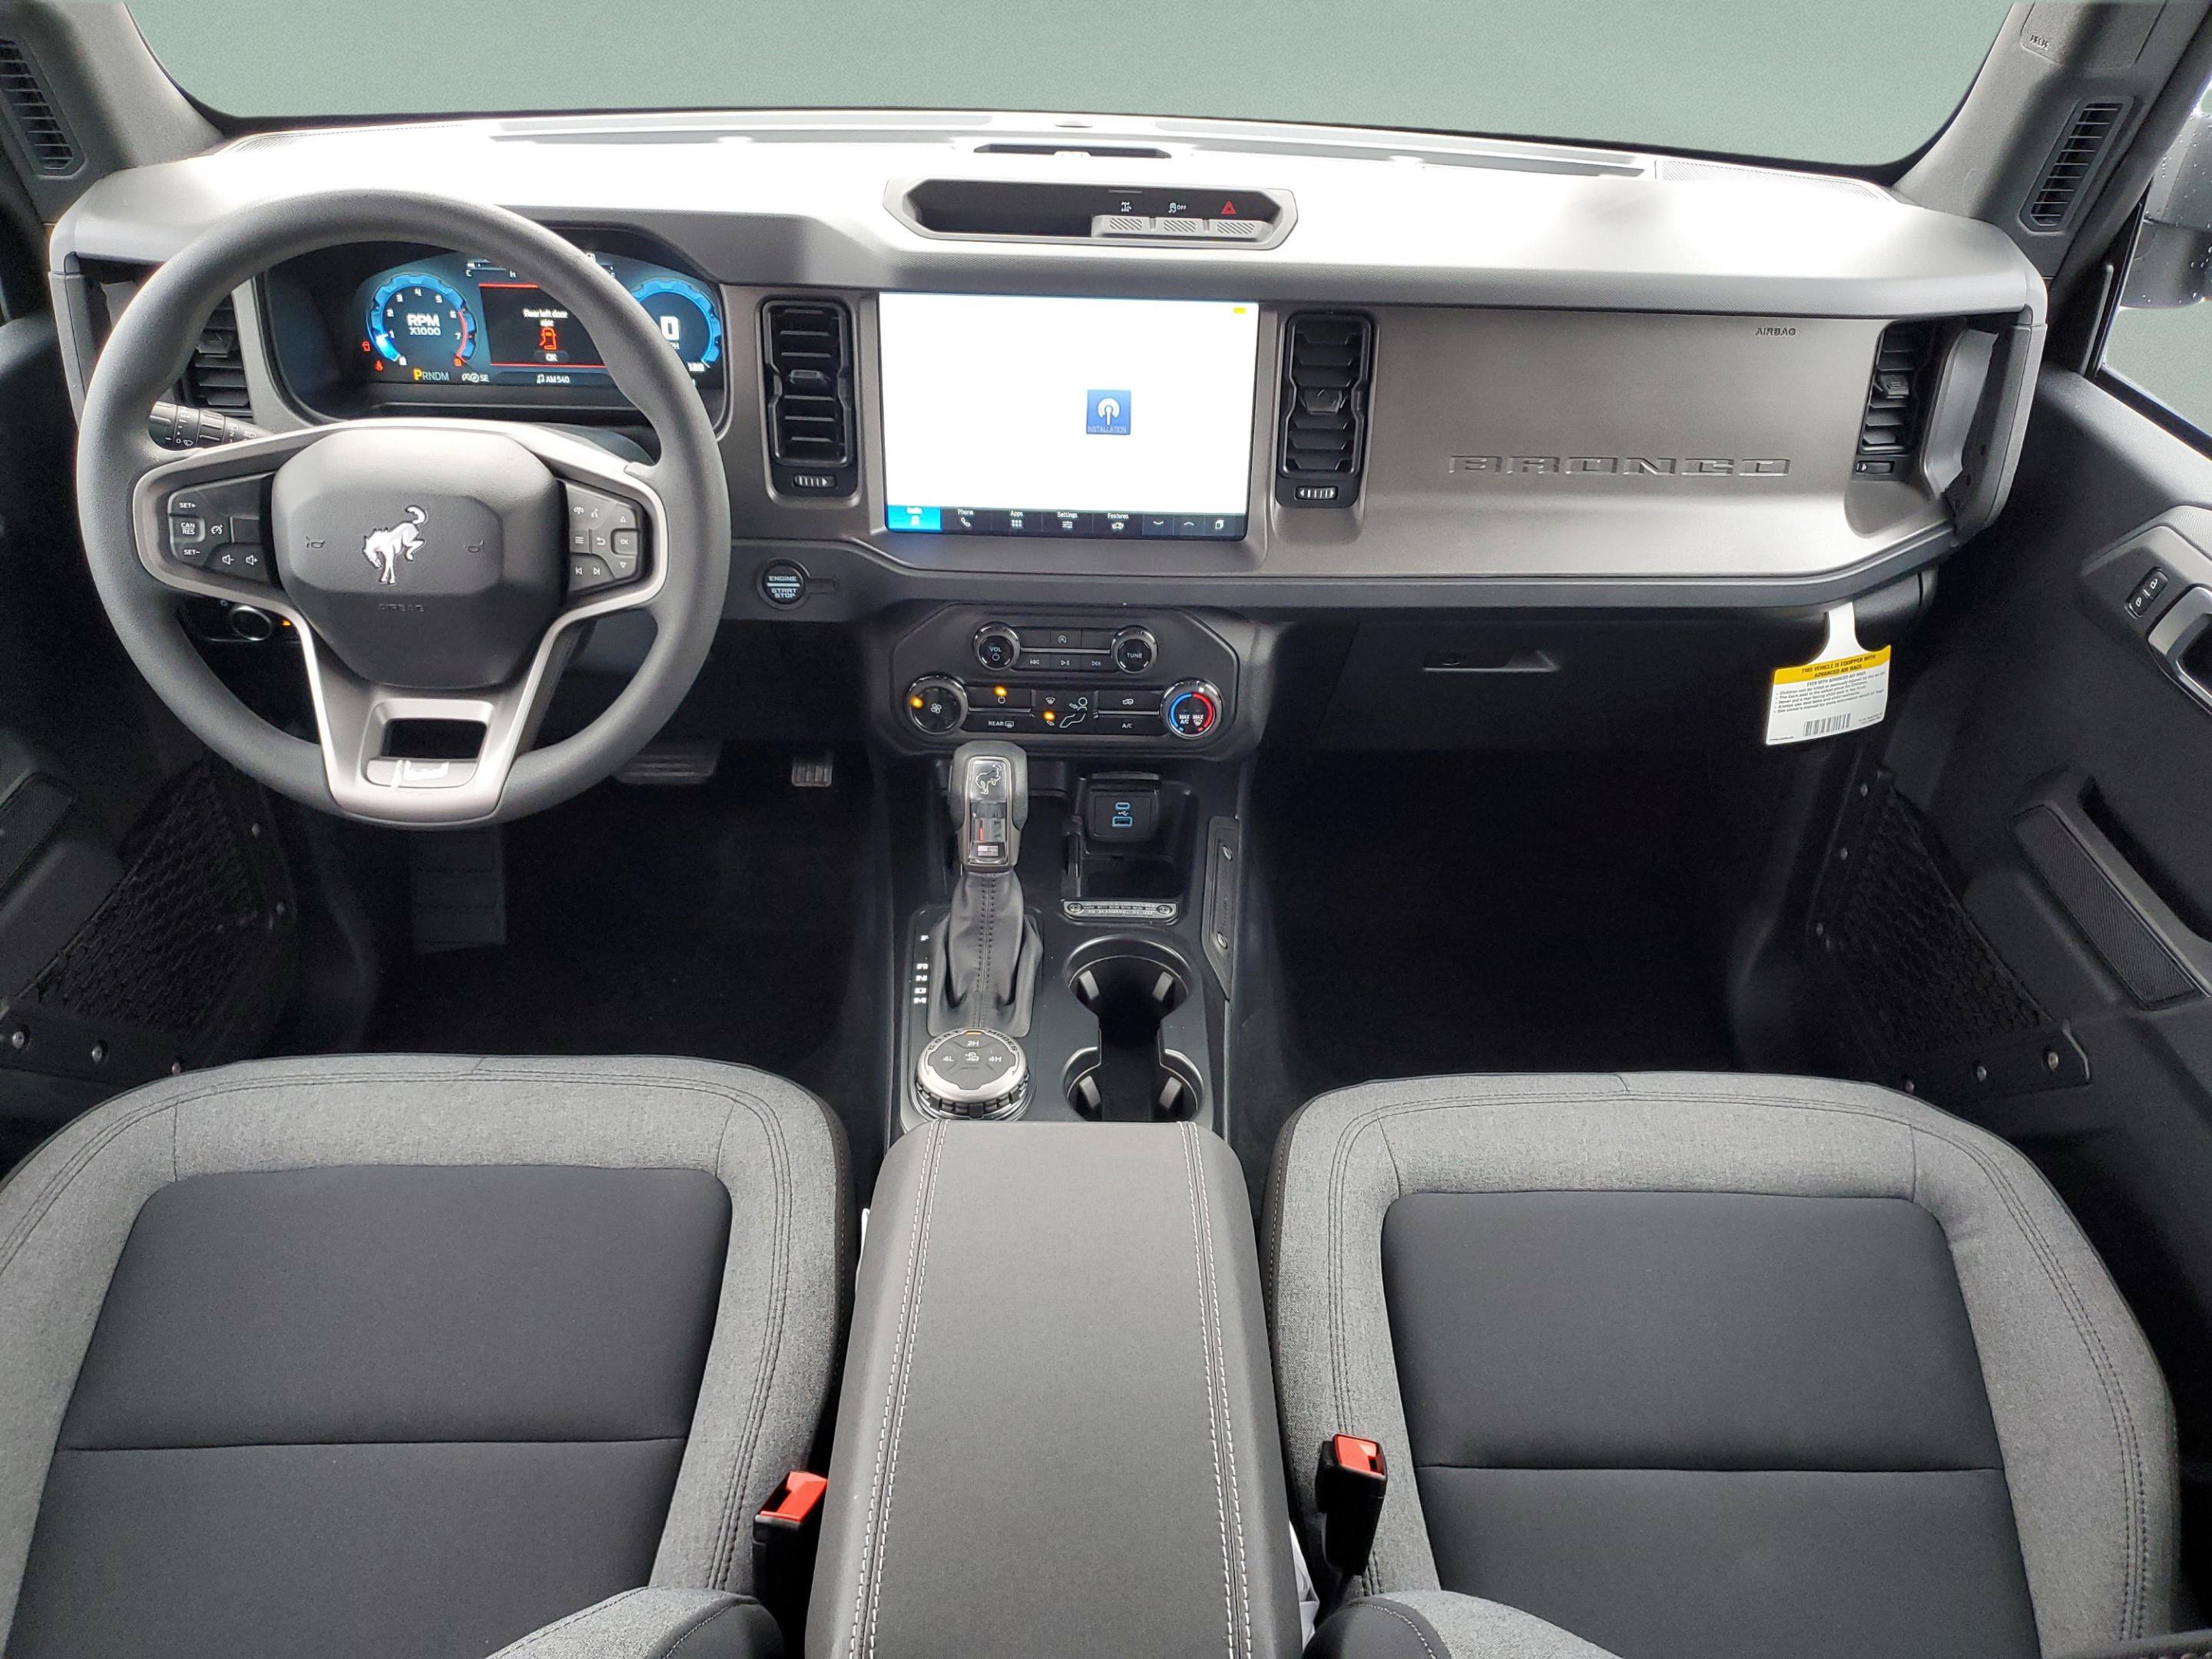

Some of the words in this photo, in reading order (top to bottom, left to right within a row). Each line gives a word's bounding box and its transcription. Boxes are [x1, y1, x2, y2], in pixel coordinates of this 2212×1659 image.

[414, 288, 422, 296] 4
[396, 293, 404, 302] 3
[435, 294, 443, 303] 5
[386, 308, 395, 316] 2
[407, 313, 441, 326] RPM
[409, 327, 442, 336] X1000
[660, 316, 680, 340] 0
[1754, 327, 1796, 336] AIRBAG
[1449, 455, 1791, 476] BRONCO
[988, 1029, 1018, 1051] MODES
